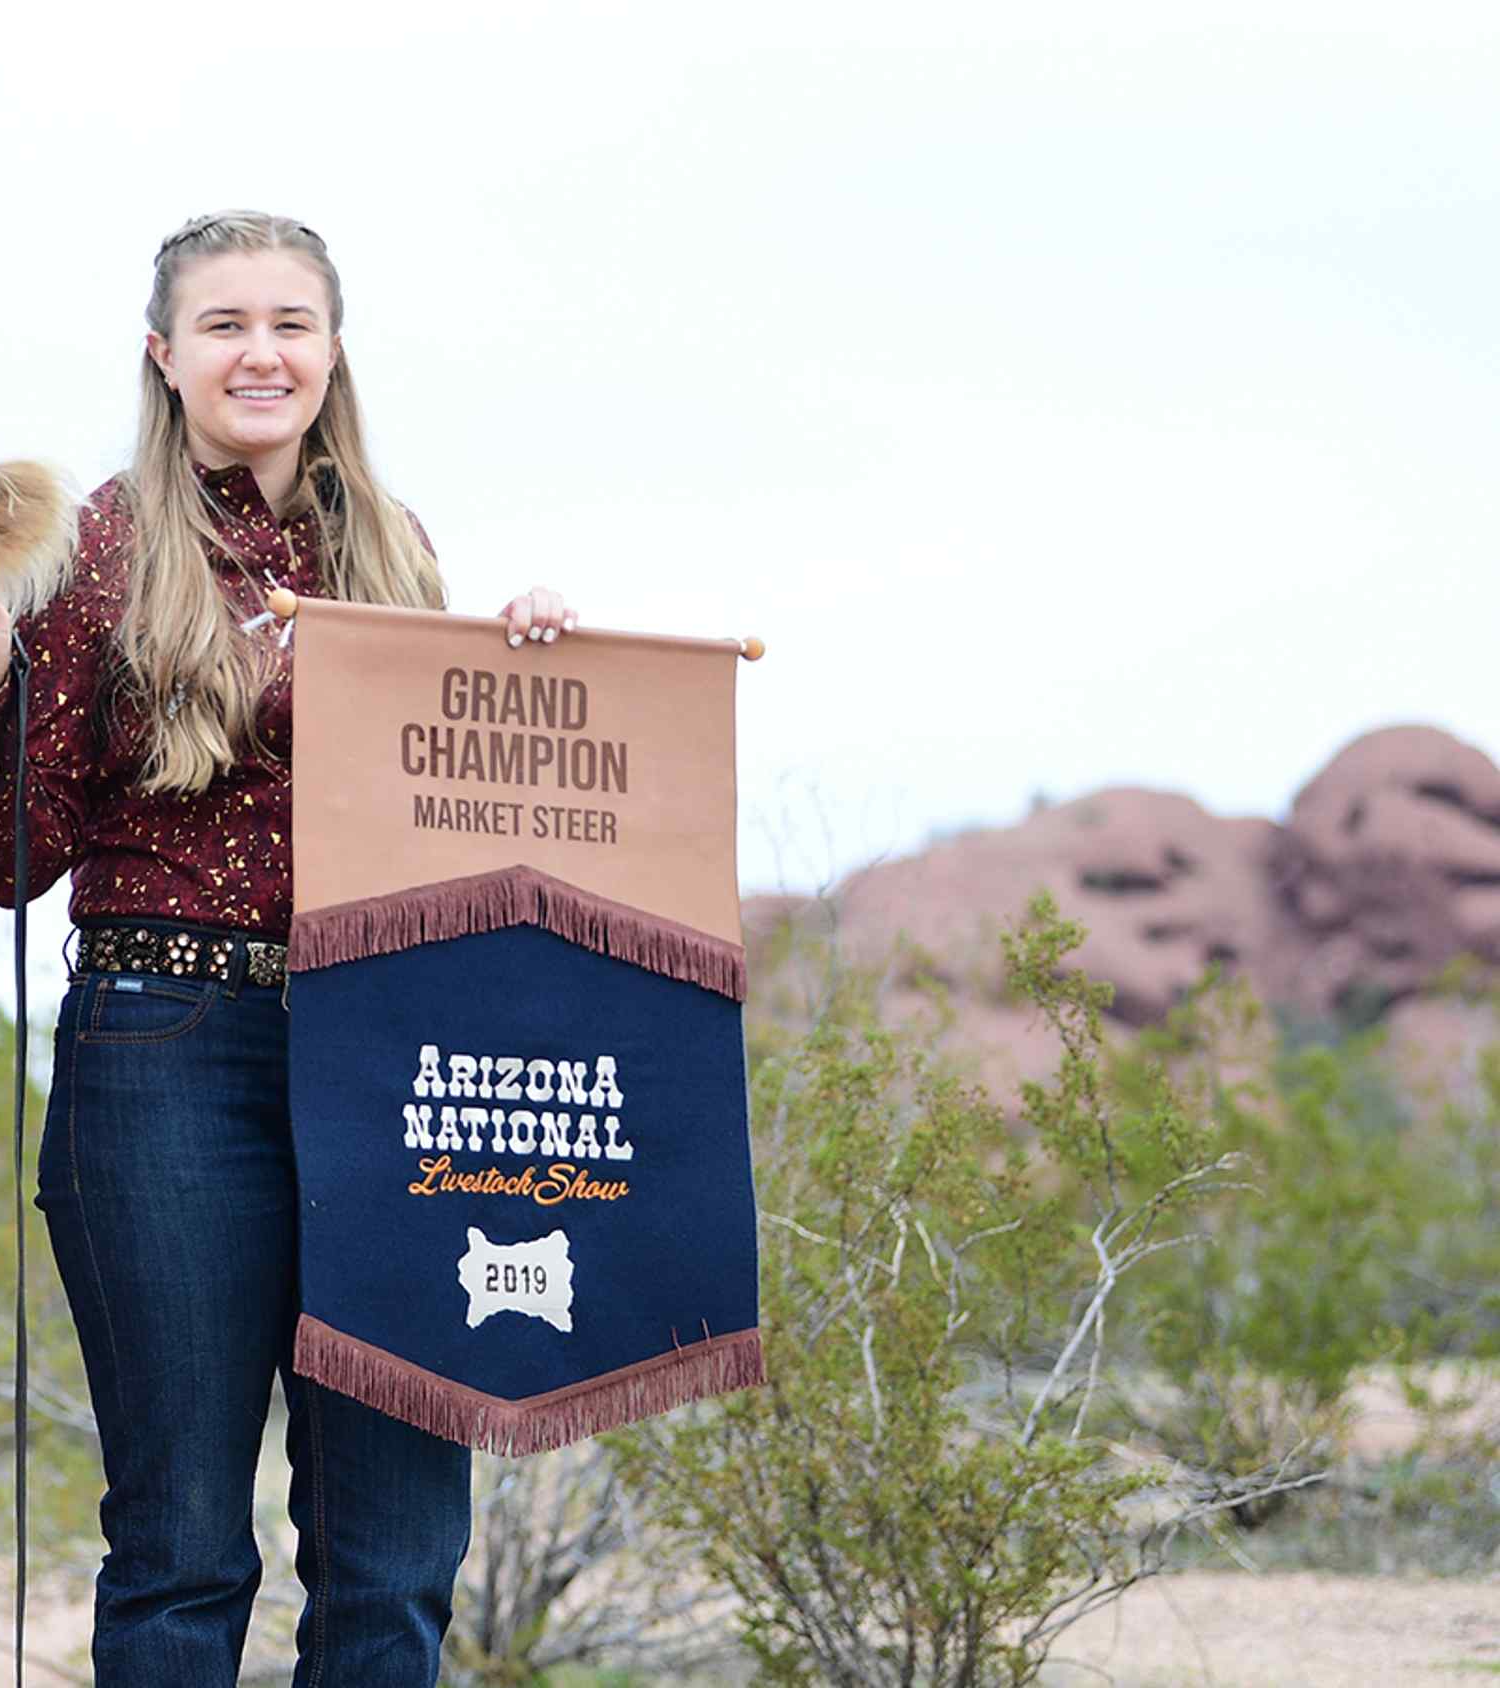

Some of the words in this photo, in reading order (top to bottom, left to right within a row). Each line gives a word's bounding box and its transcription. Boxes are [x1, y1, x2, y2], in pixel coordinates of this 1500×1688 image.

[442, 667, 587, 731] GRAND
[401, 723, 628, 793] CHAMPION
[414, 795, 523, 836] MARKET
[532, 805, 617, 844] STEER
[413, 1044, 624, 1108] ARIZONA
[402, 1104, 634, 1160] NATIONAL
[408, 1155, 534, 1196] Livestock
[533, 1163, 629, 1206] Show
[486, 1263, 547, 1295] 2019
